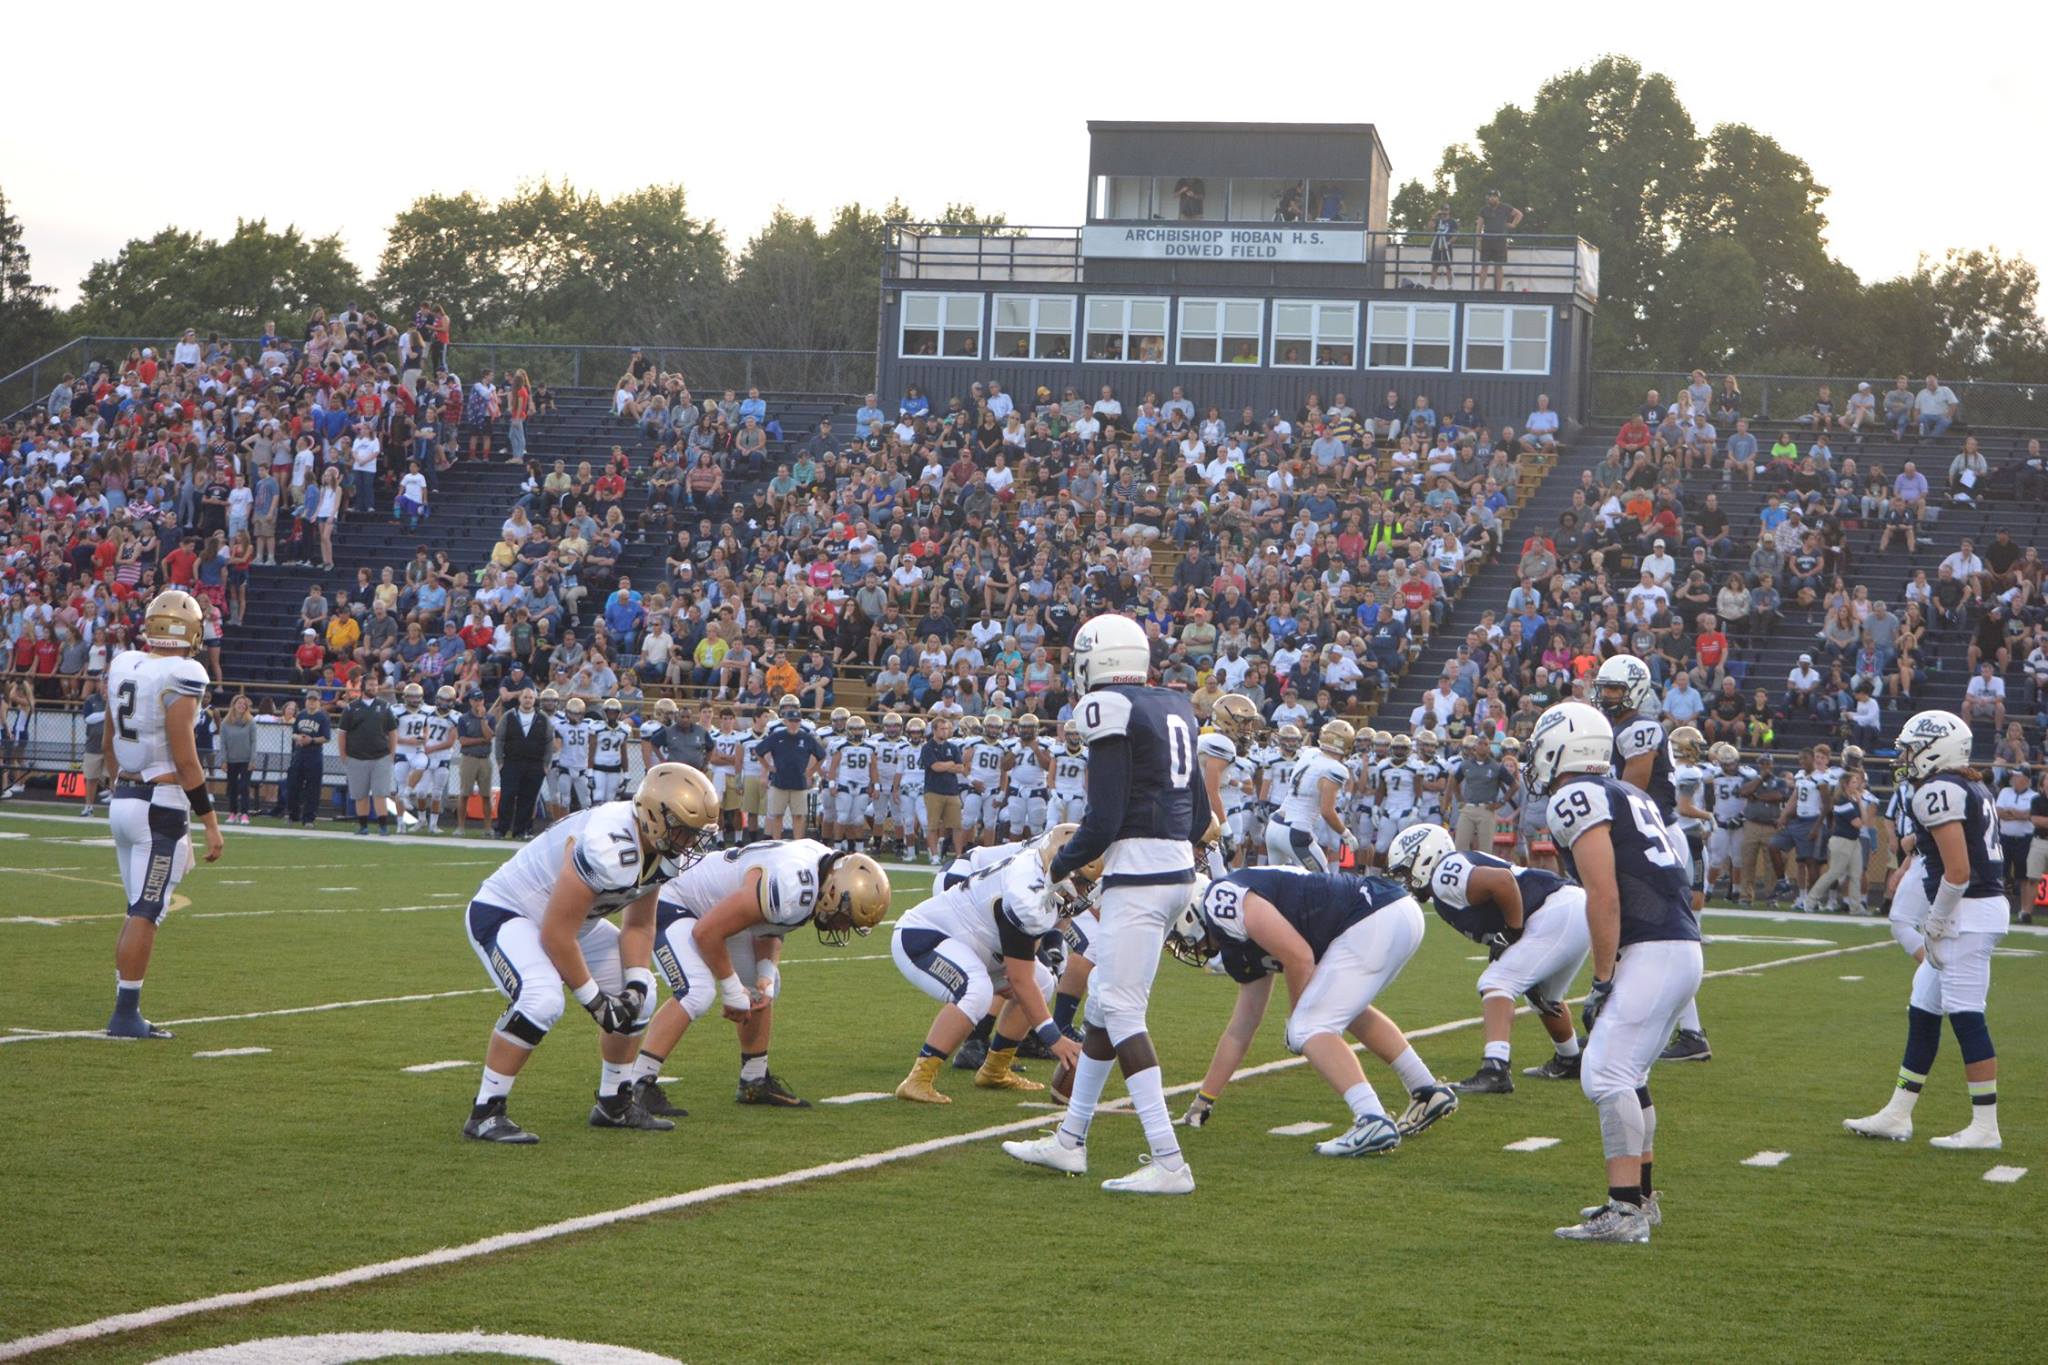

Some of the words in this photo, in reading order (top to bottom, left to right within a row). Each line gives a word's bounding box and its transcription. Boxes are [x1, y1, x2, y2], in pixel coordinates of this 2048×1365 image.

[1125, 228, 1223, 243] ARCHBISHOP
[1231, 230, 1282, 244] HOBAN
[1164, 244, 1223, 257] DOWED
[1231, 245, 1277, 258] FIELD
[117, 679, 139, 743] 2
[1086, 702, 1100, 729] 0
[406, 721, 423, 736] 18
[428, 724, 447, 741] 77
[568, 730, 586, 746] 35
[1634, 727, 1657, 748] 97
[601, 737, 621, 751] 34
[1166, 714, 1192, 789] 0
[846, 753, 868, 769] 58
[979, 751, 998, 769] 60
[1058, 763, 1079, 778] 10
[61, 774, 77, 794] 40
[1392, 775, 1401, 791] 7
[1554, 790, 1592, 828] 59
[1925, 789, 1950, 816] 21
[143, 854, 171, 902] KNIGHTS
[1440, 861, 1463, 887] 95
[1215, 888, 1237, 920] 63
[656, 945, 688, 991] KNIGHTS
